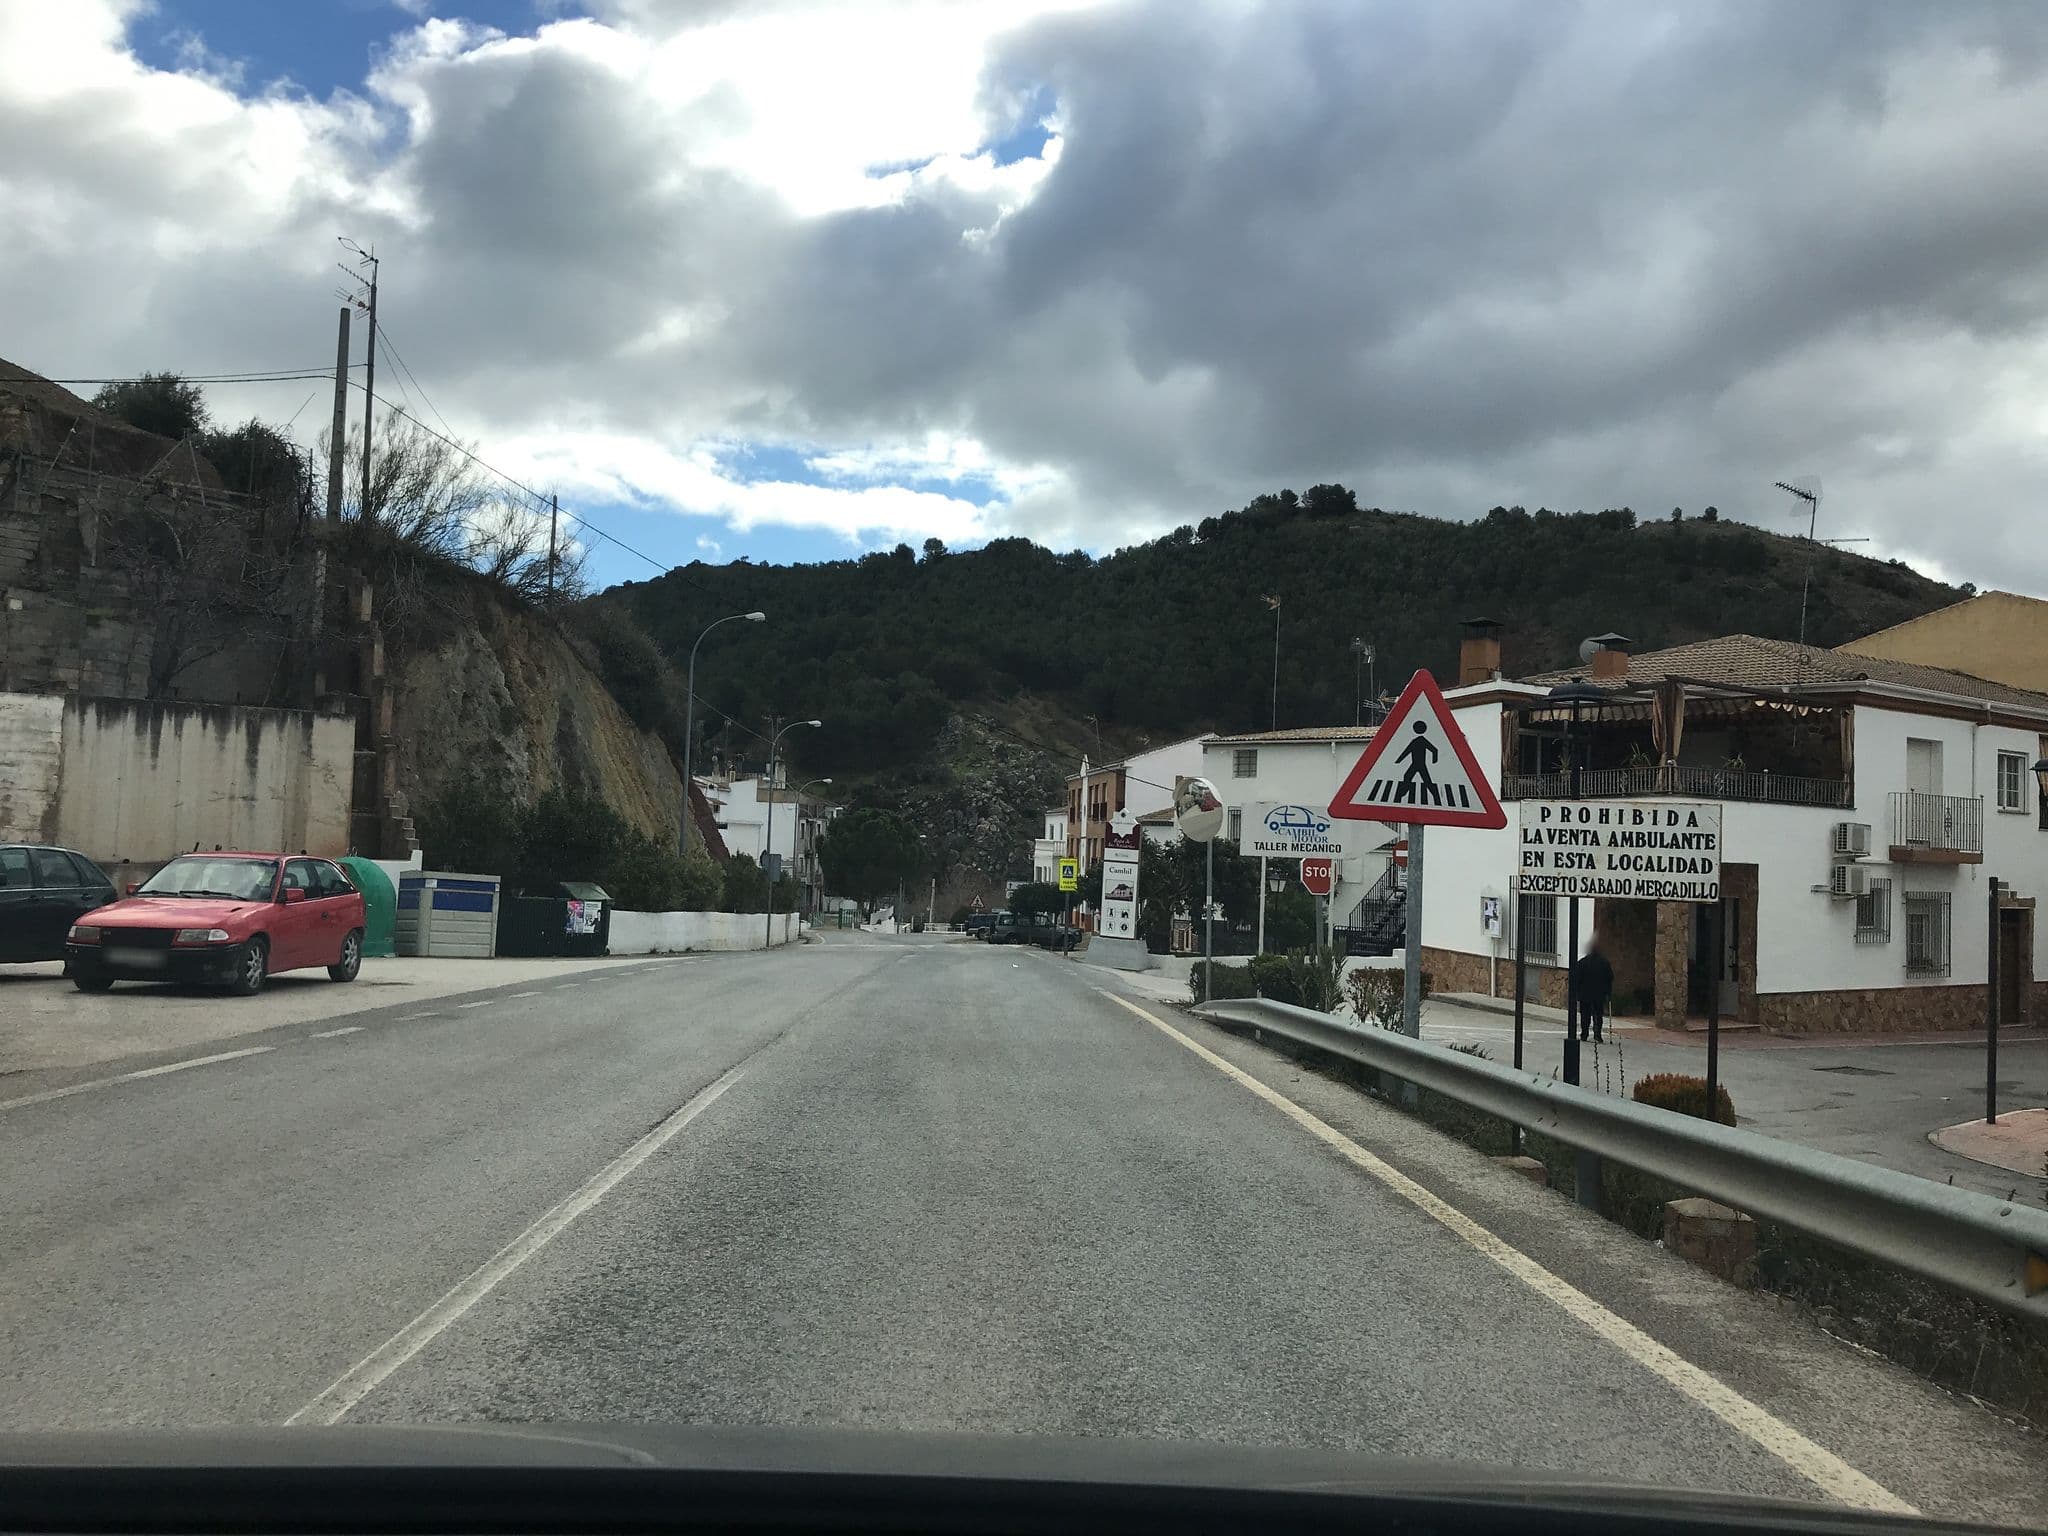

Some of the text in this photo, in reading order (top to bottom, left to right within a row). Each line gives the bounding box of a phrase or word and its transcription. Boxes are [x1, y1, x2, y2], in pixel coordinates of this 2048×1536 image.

[1540, 806, 1699, 828] PROHIBIDA
[1253, 841, 1342, 853] TALLER MECANICO
[1522, 828, 1716, 851] LA VENTA AMBULANTE
[1522, 850, 1714, 875] EN ESTA LOCALIDAD
[1519, 874, 1719, 900] EXCEPTO SABADO MERCADILLO
